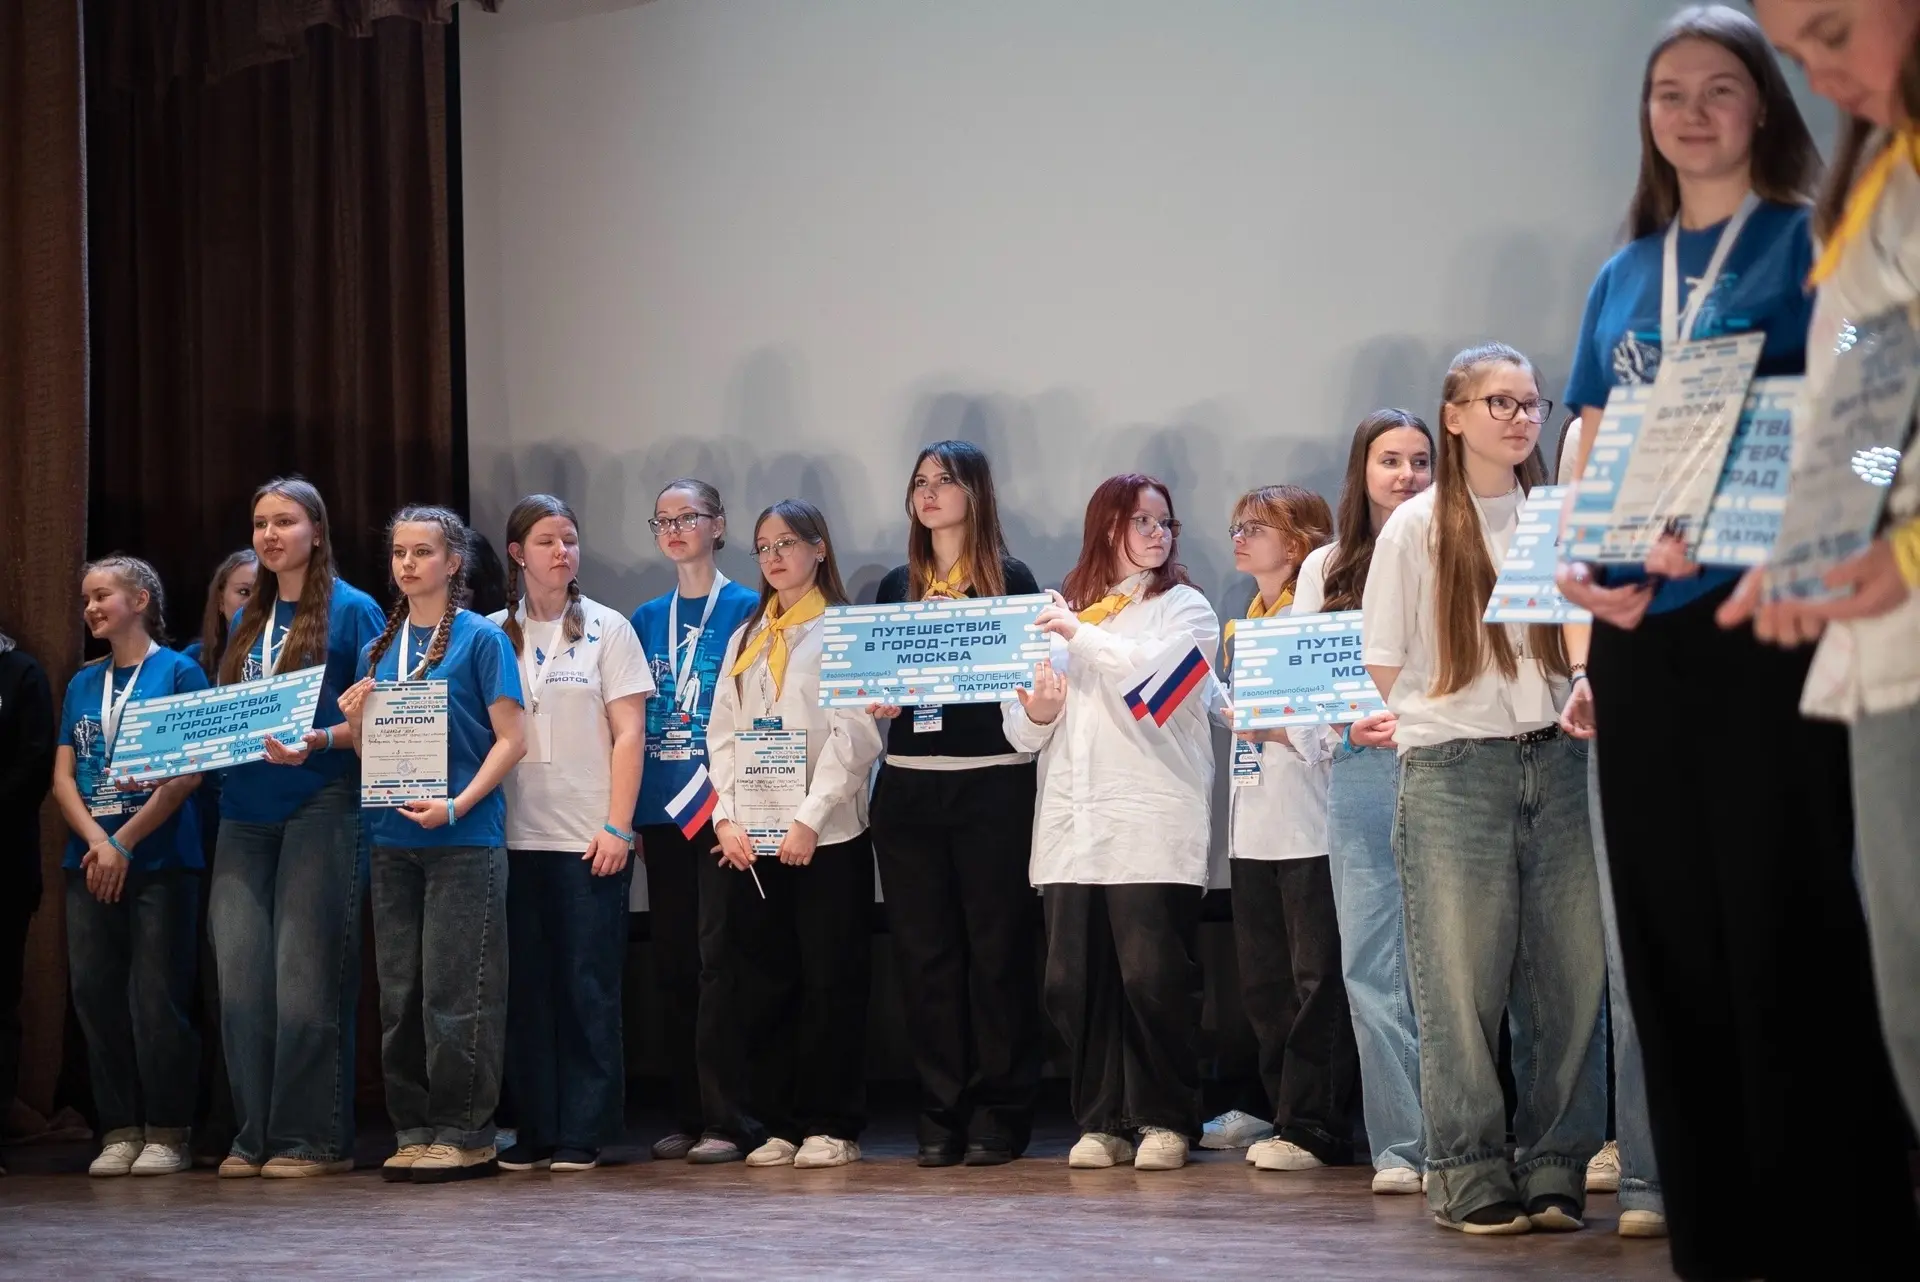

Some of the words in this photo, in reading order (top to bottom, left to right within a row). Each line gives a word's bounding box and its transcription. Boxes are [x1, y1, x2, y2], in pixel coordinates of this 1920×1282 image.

[872, 620, 1001, 638] ПУТЕШЕСТВИЕ
[865, 641, 875, 651] В
[882, 632, 1007, 651] ГОРОД-ГЕРОЙ
[897, 651, 972, 664] МОСКВА
[1289, 655, 1302, 666] В
[952, 672, 1021, 682] ПОКОЛЕНИЕ
[1242, 684, 1325, 697] #волонтерыпобеды43
[164, 693, 280, 722] ПУТЕШЕСТВИЕ
[156, 725, 167, 735] В
[172, 704, 282, 732] ГОРОД-ГЕРОЙ
[375, 716, 435, 725] ДИПЛОМ
[183, 721, 249, 741] МОСКВА
[745, 766, 796, 774] ДИПЛОМ
